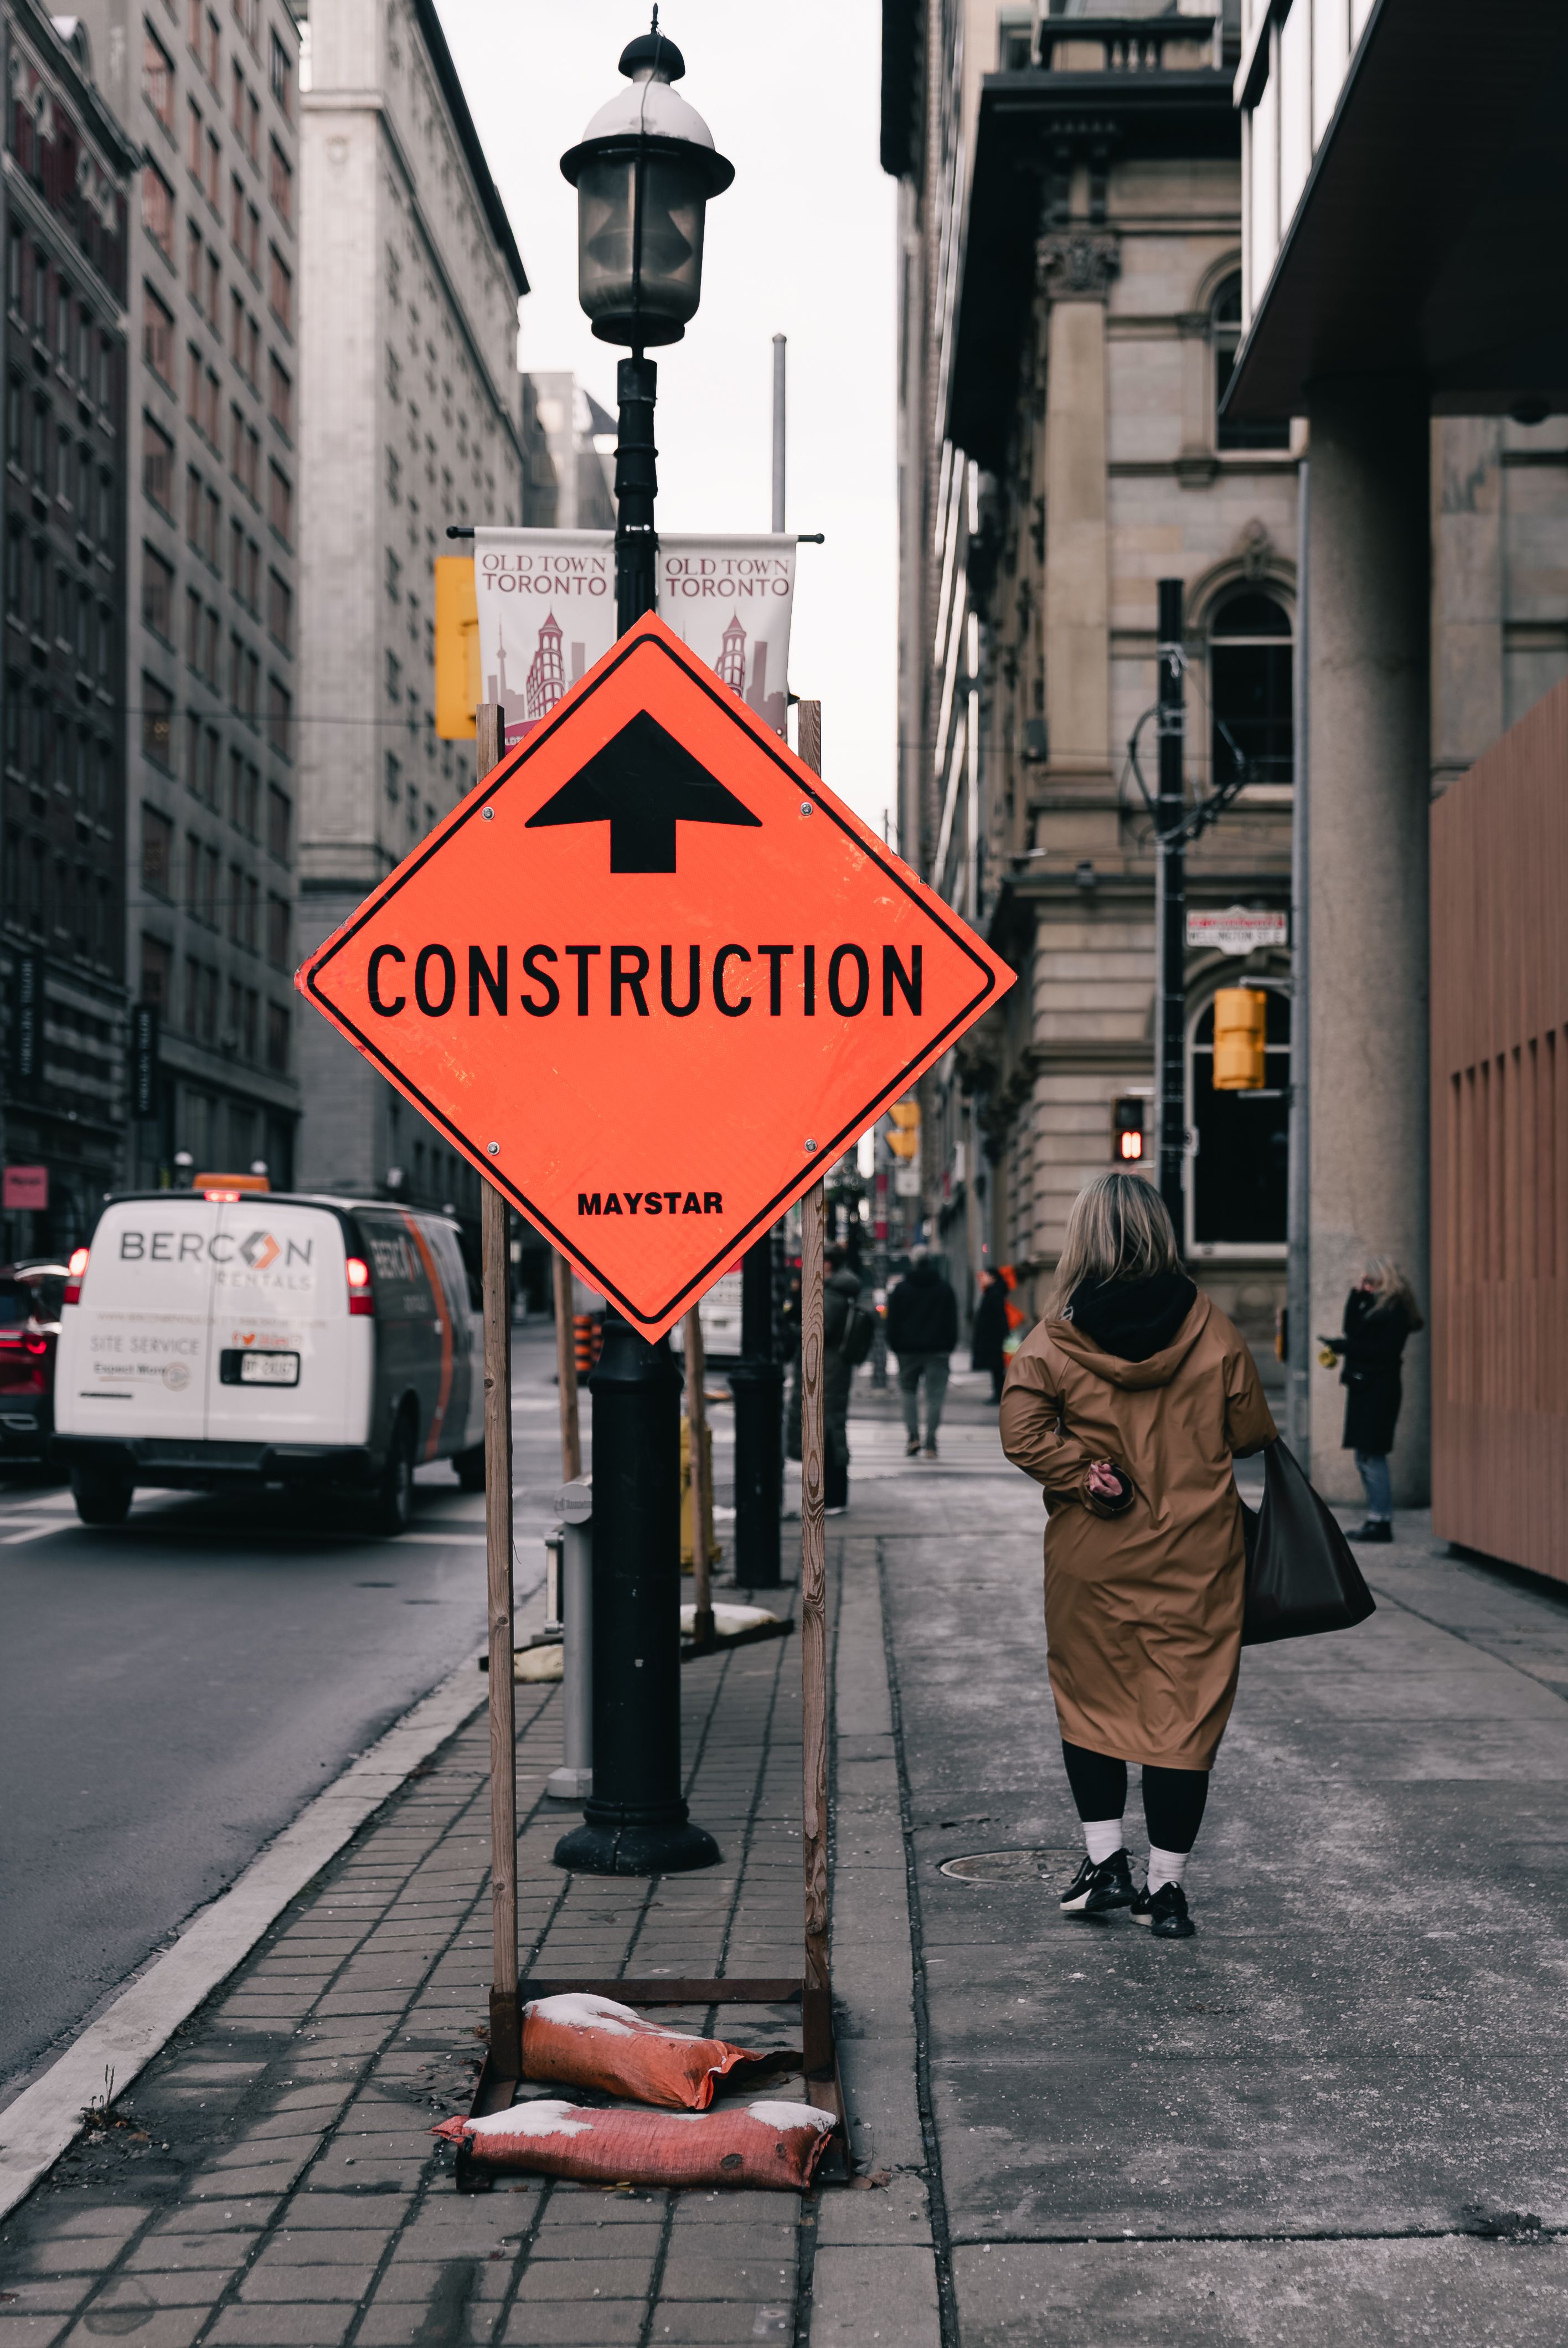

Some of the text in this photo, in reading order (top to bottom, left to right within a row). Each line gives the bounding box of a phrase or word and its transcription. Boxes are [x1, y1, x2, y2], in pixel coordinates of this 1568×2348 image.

[482, 554, 607, 574] OLD TOWN
[666, 558, 790, 575] OLD TOWN
[482, 573, 607, 596] TORONTO
[666, 578, 790, 598] TORONTO
[368, 943, 924, 1018] CONSTRUCTION
[577, 1191, 724, 1216] MAYSTAR
[215, 1270, 312, 1291] RENTALS
[89, 1334, 200, 1356] SITE SERVICE
